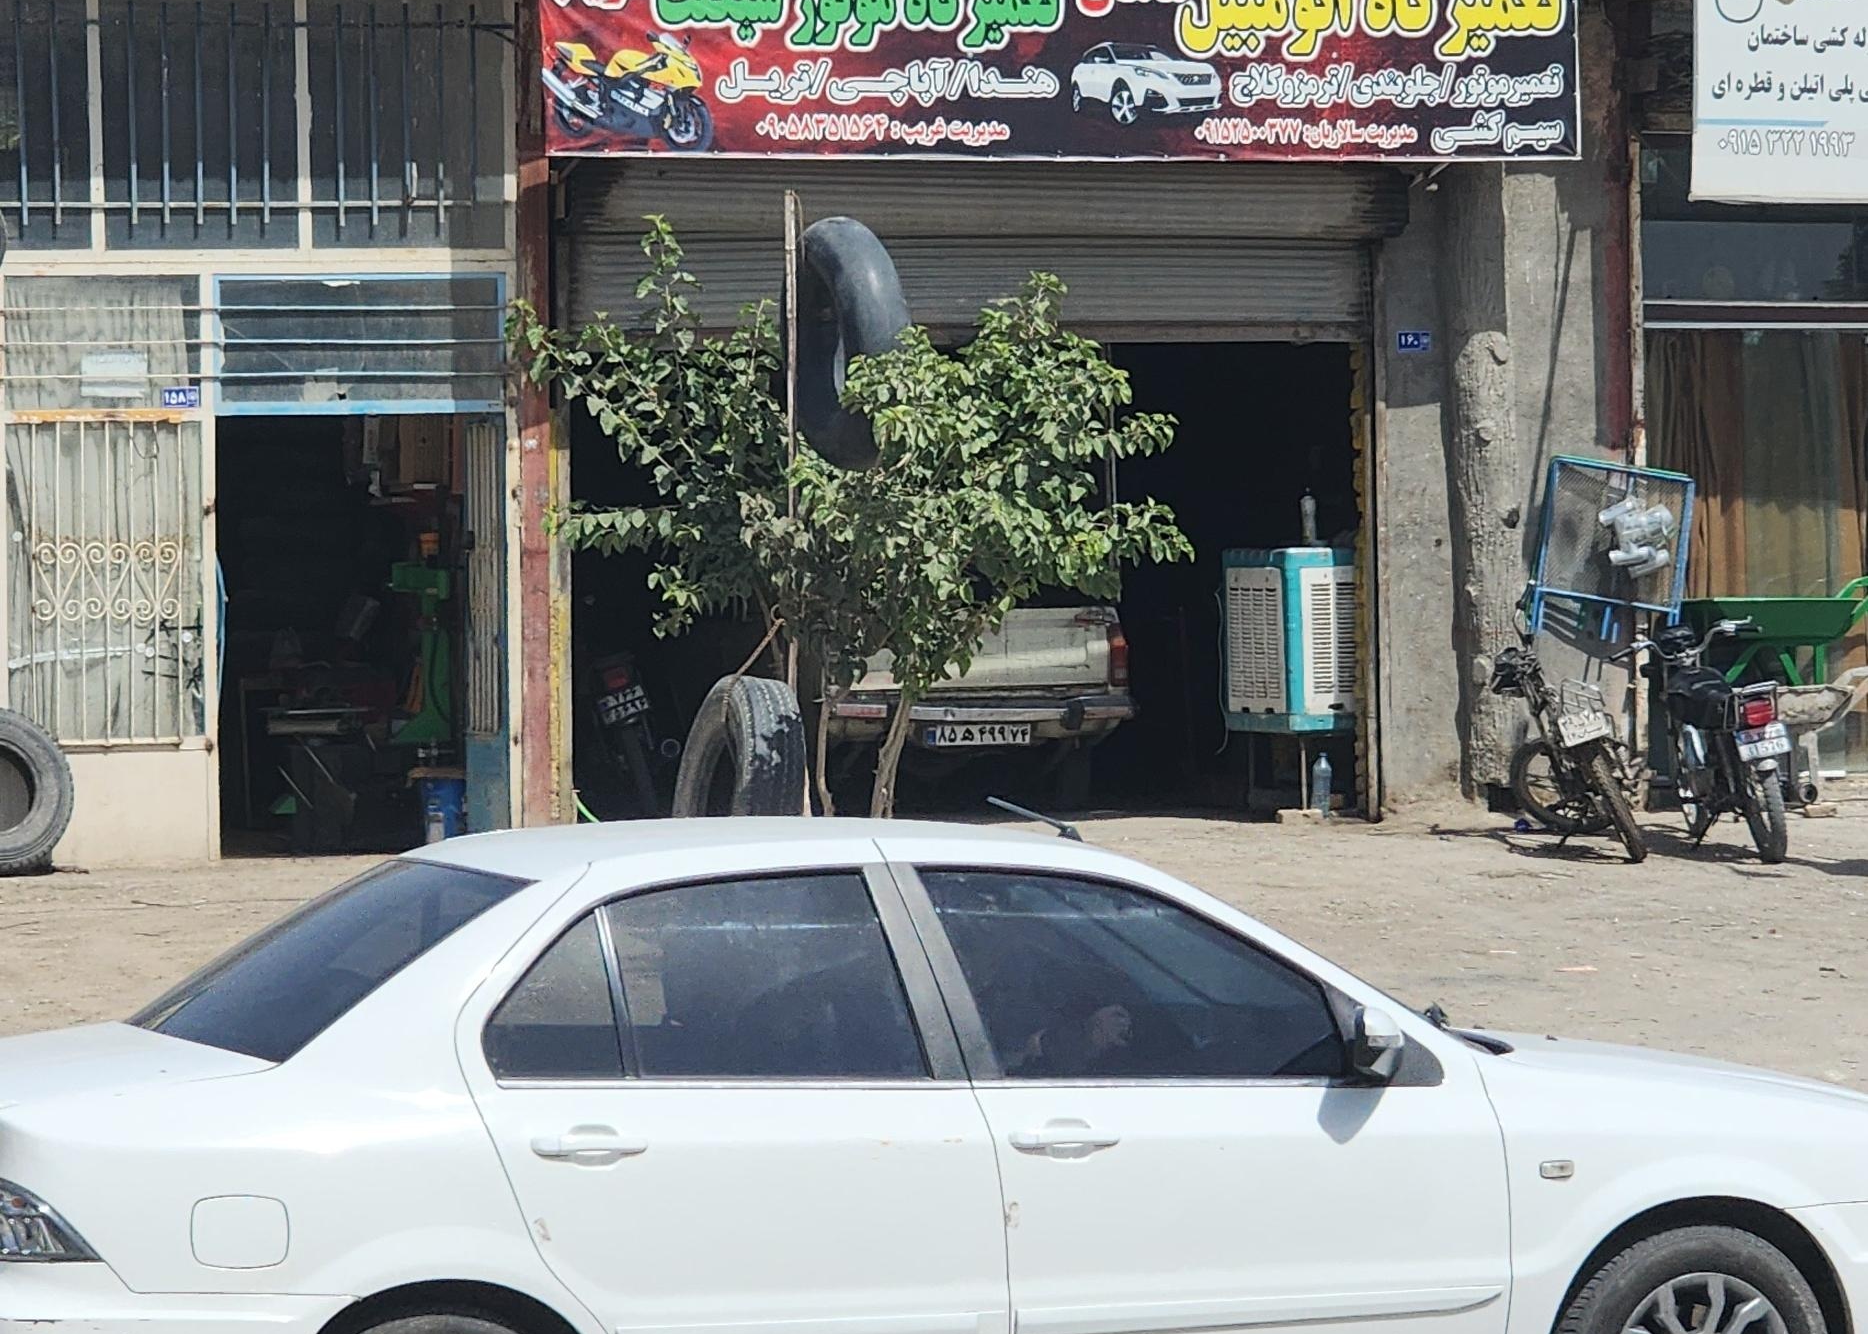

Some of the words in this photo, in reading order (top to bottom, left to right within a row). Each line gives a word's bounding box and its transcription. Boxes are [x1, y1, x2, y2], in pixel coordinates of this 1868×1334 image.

[1747, 23, 1809, 52] ساختمان
[1813, 26, 1849, 54] کشی
[1853, 25, 1868, 48] له
[1711, 71, 1732, 99] ای
[1736, 70, 1773, 100] قطره
[1776, 82, 1786, 102] و
[1790, 73, 1825, 101] اتیلن
[1829, 73, 1855, 104] پلی
[755, 112, 890, 141] ۰۹۰۵۸۳۵۱۵۶۴
[947, 120, 1010, 147] مدیریت
[1194, 117, 1302, 145] ۰۹۱۵۲۵۰۰۳۷۷
[1365, 123, 1418, 149] مدیریت
[1430, 109, 1505, 152] کشی
[1502, 118, 1564, 151] سیم
[1718, 128, 1762, 156] ۰۹۱۵
[1765, 129, 1805, 156] ۳۲۲
[1809, 130, 1856, 157] ۱۹۹۳
[164, 391, 187, 404] ۱۵۸
